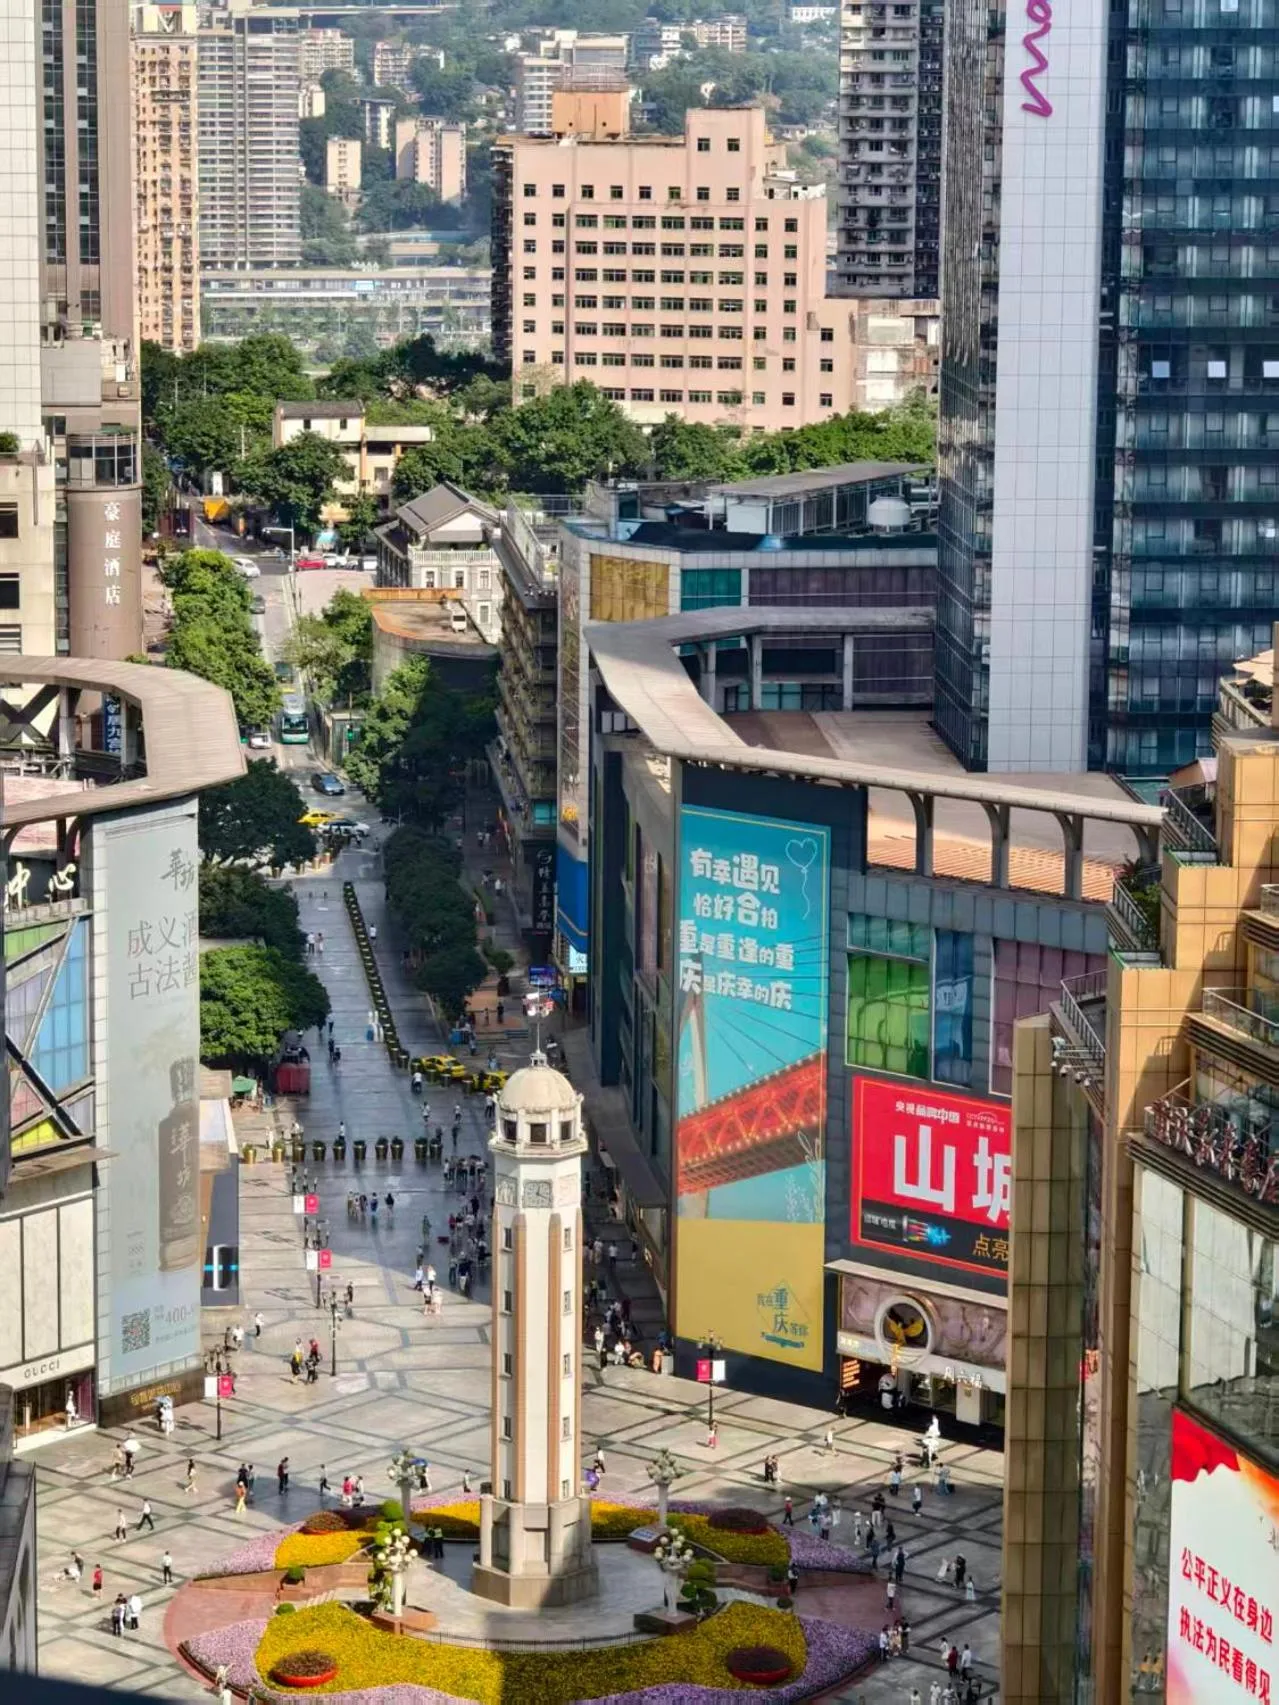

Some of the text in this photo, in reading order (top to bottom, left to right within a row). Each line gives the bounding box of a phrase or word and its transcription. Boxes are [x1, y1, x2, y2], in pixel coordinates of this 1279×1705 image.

[103, 501, 121, 607] 豪庭酒店
[4, 861, 76, 914] 中心
[690, 848, 780, 894] 有幸遇见
[693, 891, 778, 930] 恰好合拍
[23, 1359, 60, 1379] GUCCI
[1180, 1546, 1273, 1644] 公平正义在身边
[1179, 1604, 1271, 1705] 执法为民看得见
